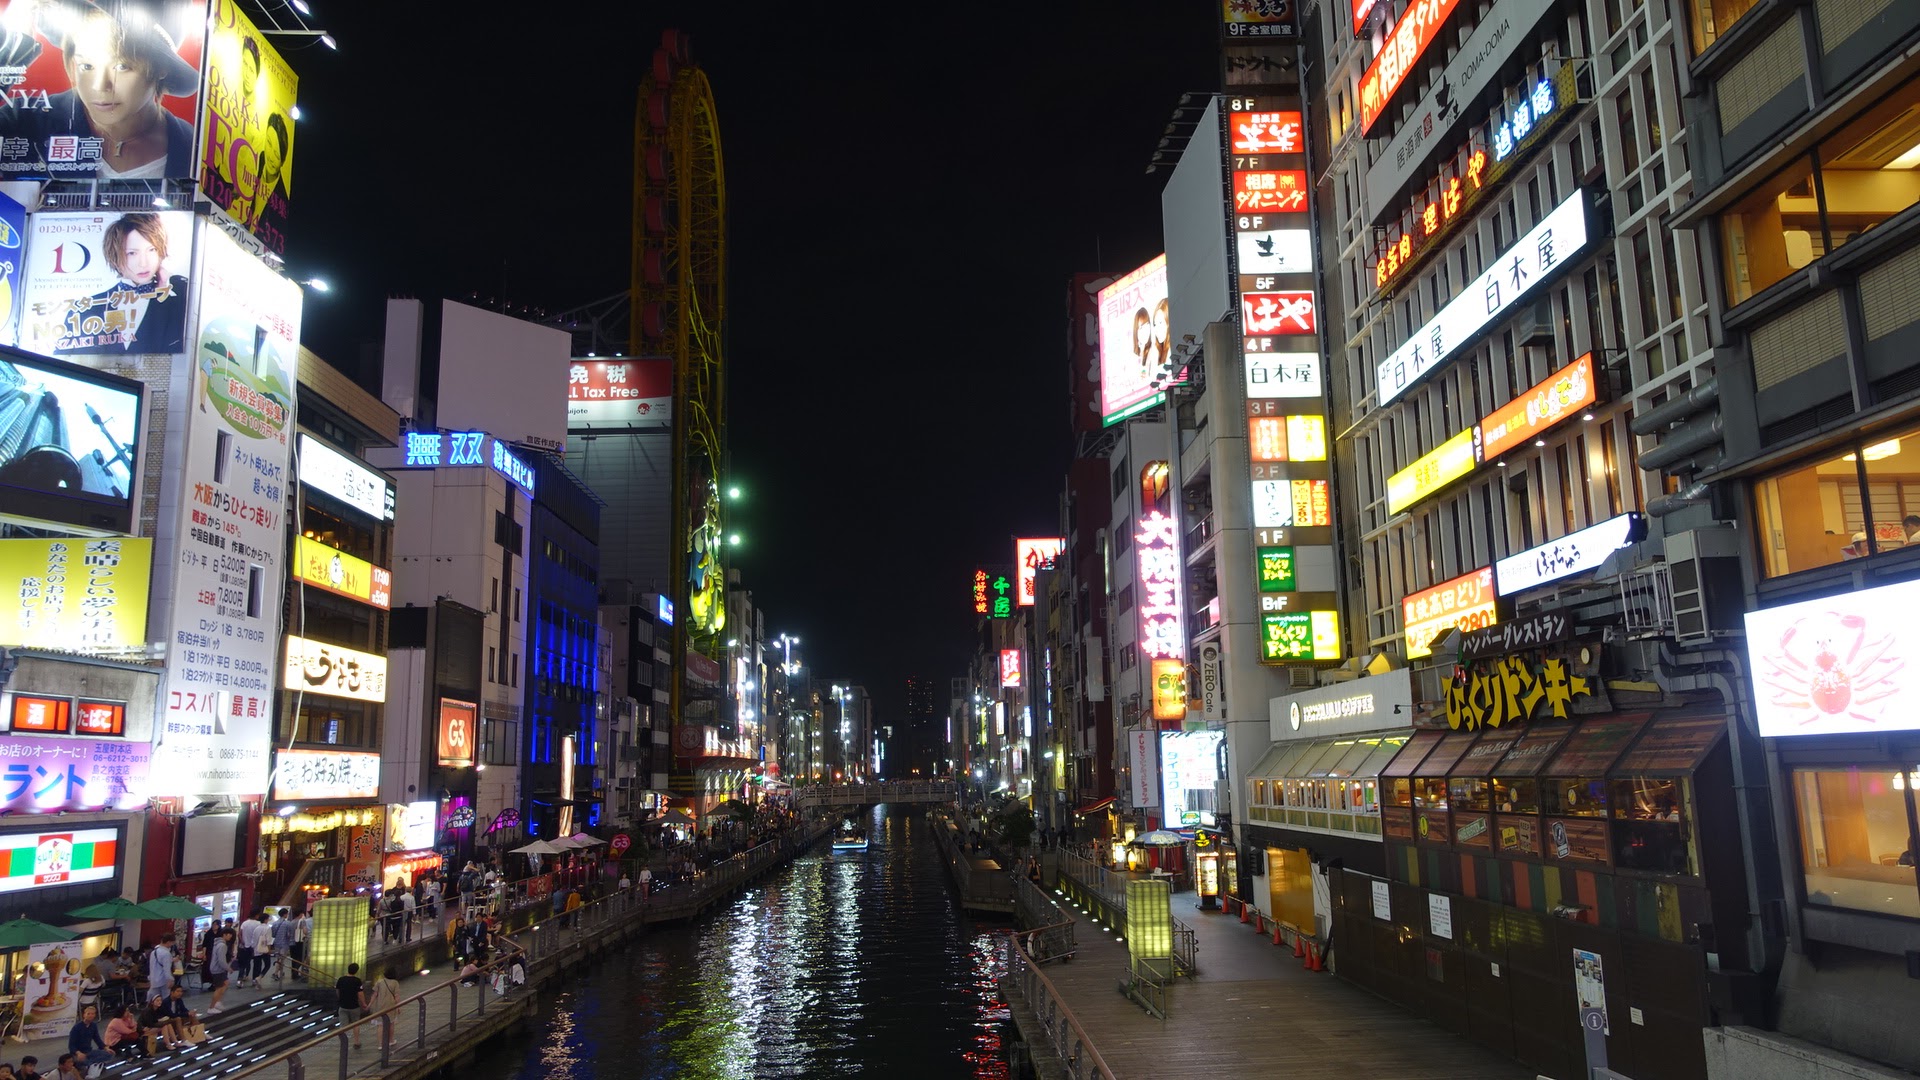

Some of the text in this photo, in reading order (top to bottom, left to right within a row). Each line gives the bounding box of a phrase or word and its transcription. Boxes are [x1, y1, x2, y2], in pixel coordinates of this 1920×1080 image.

[1229, 22, 1292, 36] 9F 全室個室
[1461, 18, 1511, 87] DOMA-DOMA
[210, 65, 260, 132] OSAKA
[1231, 99, 1255, 111] 8F
[207, 84, 250, 137] HOST
[49, 136, 104, 161] 最高
[202, 108, 258, 201] FC
[1235, 157, 1259, 169] 7F
[1246, 174, 1276, 190] 相席
[1236, 190, 1306, 209] ダイニング
[200, 167, 285, 255] 0120-194-373
[39, 224, 103, 233] 0120-194-373
[1239, 216, 1263, 229] 6F
[1486, 228, 1558, 315] 白木屋
[1255, 277, 1275, 290] 5F
[1246, 338, 1272, 352] 4F
[1394, 324, 1445, 390] 白木屋
[569, 365, 627, 384] 免税
[1251, 361, 1314, 384] 白木屋
[583, 387, 606, 398] Tax
[610, 386, 639, 397] Free
[1252, 401, 1275, 414] 3F
[407, 433, 484, 465] 無双
[1255, 465, 1279, 478] 2F
[1260, 530, 1284, 544] 1F
[373, 568, 390, 587] 17:00
[218, 586, 244, 608] 7,800円
[1262, 596, 1288, 611] B1F
[1267, 621, 1308, 641] びっくり
[1460, 610, 1490, 633] 280
[236, 626, 265, 643] 3,780円
[1462, 614, 1565, 654] ハンバーグレストラン
[1266, 639, 1312, 657] ドンキー
[1204, 663, 1215, 713] ZERO cafe
[1441, 655, 1591, 732] びっくりドンキー
[170, 691, 214, 714] コスパ
[1341, 694, 1374, 717] COFFEE
[28, 703, 46, 725] 酒
[77, 709, 112, 729] たばこ
[448, 718, 465, 747] G3
[684, 732, 698, 744] 24
[93, 754, 148, 762] 06-6212-3013
[3, 764, 87, 801] ラント
[453, 820, 469, 828] BAR
[612, 840, 630, 849] G3
